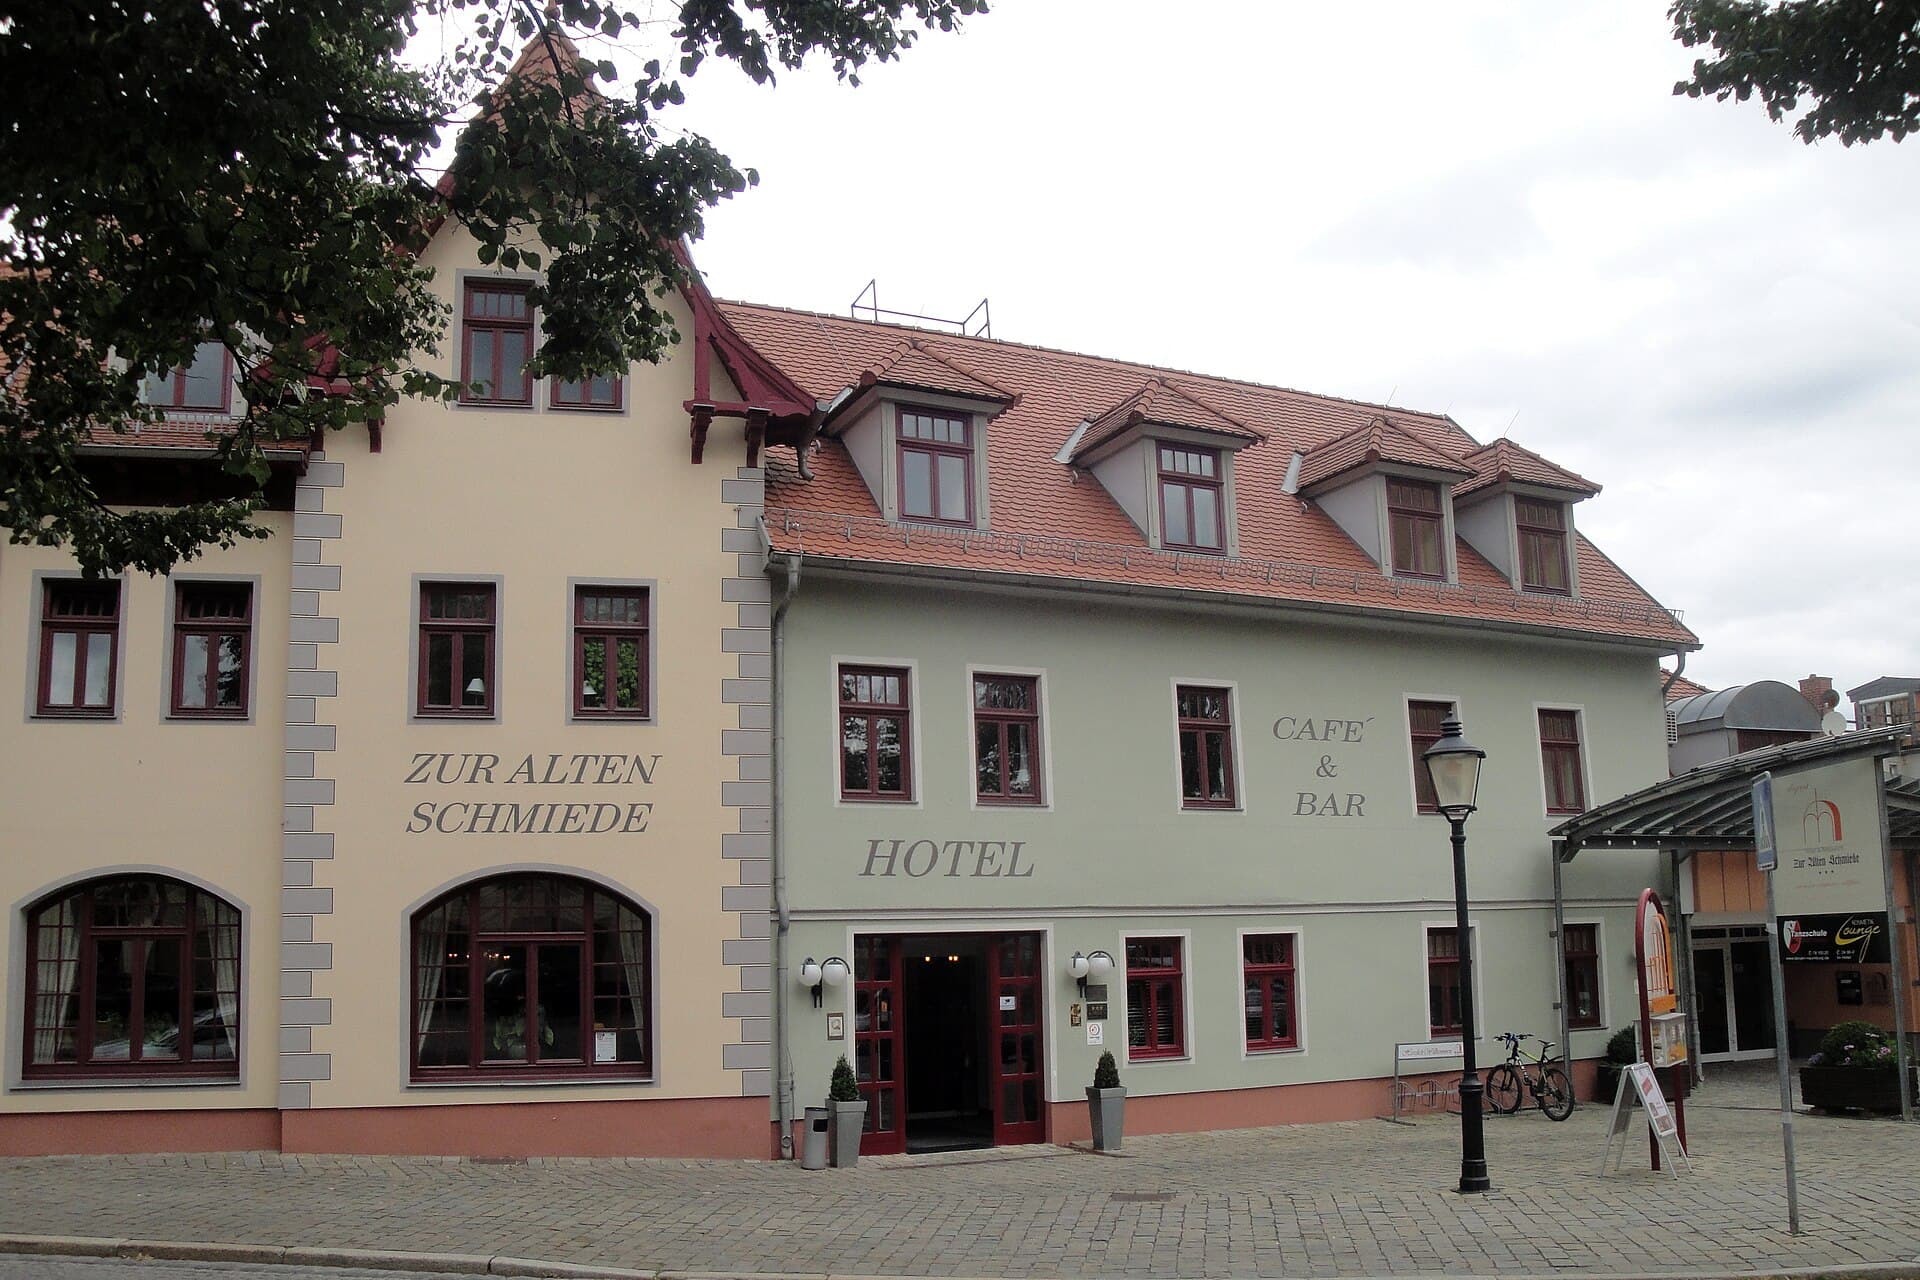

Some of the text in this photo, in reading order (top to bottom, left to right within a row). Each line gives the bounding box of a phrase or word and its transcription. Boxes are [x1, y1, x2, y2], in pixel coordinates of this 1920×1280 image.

[403, 753, 663, 785] ZUR ALTEN
[1316, 754, 1338, 778] &
[405, 802, 654, 834] SCHMIEDE
[1292, 791, 1366, 817] BAR
[858, 839, 1035, 878] HOTEL
